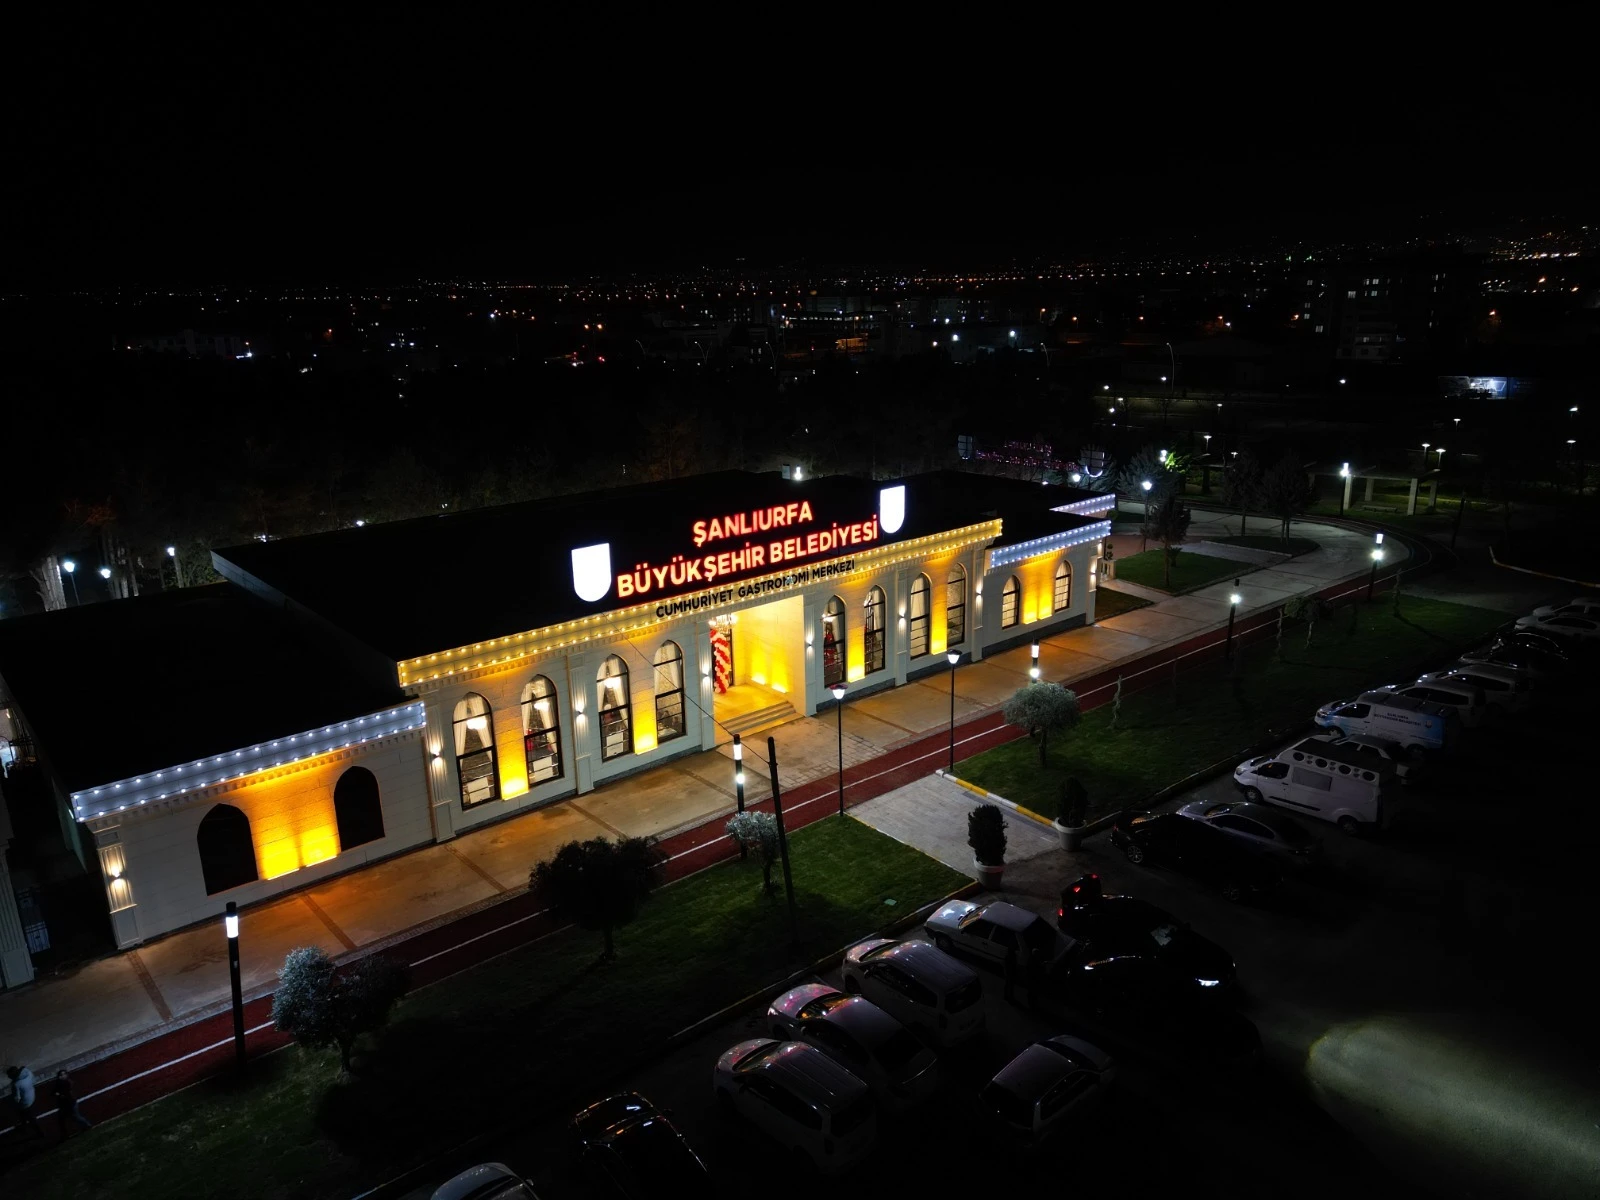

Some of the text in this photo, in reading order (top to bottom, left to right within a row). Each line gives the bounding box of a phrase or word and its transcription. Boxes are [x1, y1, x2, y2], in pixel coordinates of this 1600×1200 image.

[693, 501, 813, 547] ŞANLIURFA
[617, 514, 878, 597] BÜYÜKŞEHİR BELEDİYESİ
[656, 589, 733, 617] CUMHURİYET
